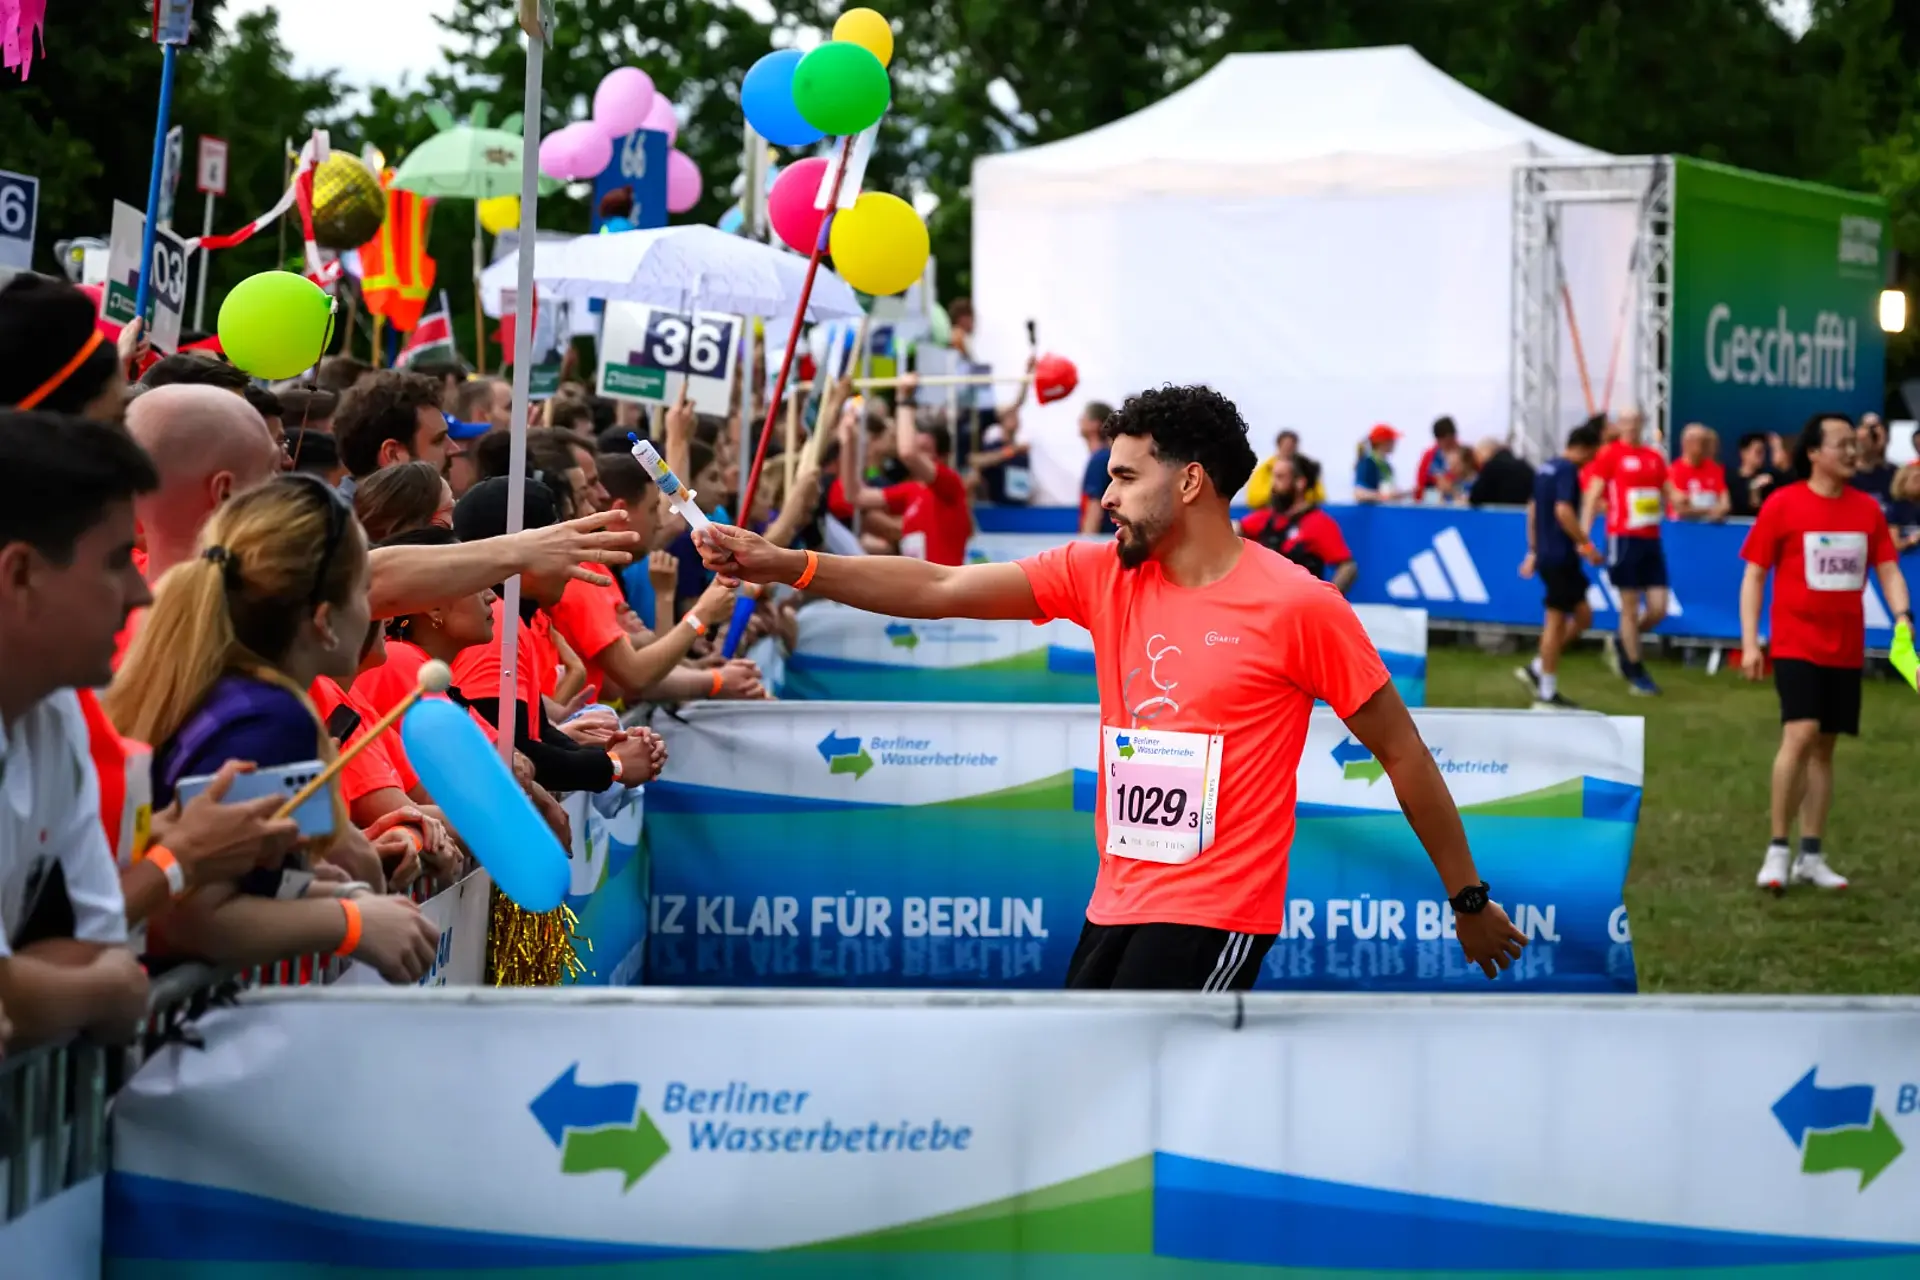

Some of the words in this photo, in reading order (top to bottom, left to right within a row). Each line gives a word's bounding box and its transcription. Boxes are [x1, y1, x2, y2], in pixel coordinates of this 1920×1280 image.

[652, 318, 722, 372] 36
[1705, 302, 1857, 391] Geschafft!
[871, 736, 931, 750] Berliner
[881, 752, 998, 767] Wasserbetriebe
[1439, 759, 1509, 774] rbetriebe
[1117, 783, 1187, 827] 1029
[1188, 812, 1198, 829] 3
[696, 895, 799, 937] KLAR
[811, 890, 892, 937] FÜR
[903, 896, 1049, 938] BERLIN.
[1326, 893, 1407, 940] FÜR
[662, 1079, 811, 1115] Berliner
[689, 1117, 974, 1153] Wasserbetriebe
